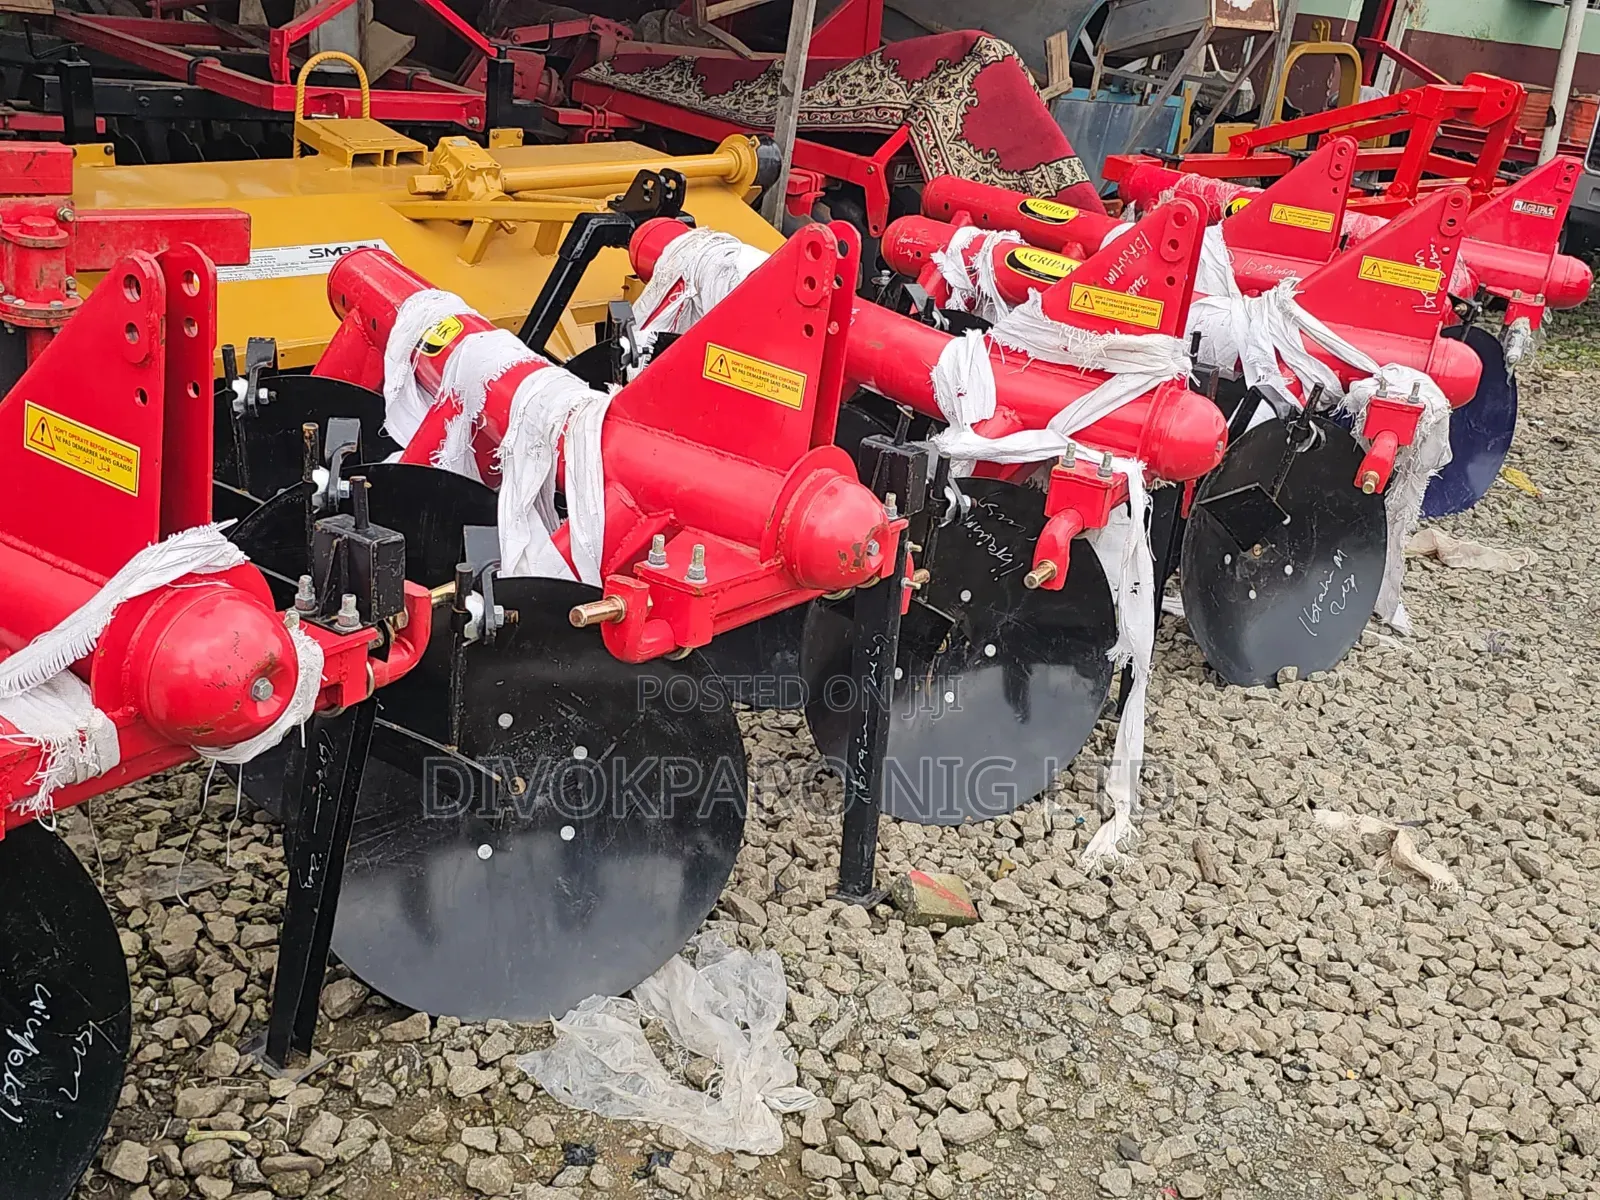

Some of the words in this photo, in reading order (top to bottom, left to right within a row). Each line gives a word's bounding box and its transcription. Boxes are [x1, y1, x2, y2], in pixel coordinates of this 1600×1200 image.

[1029, 201, 1075, 216] AGRIPAK
[53, 425, 68, 437] DON'T
[68, 432, 89, 446] OPERATE
[89, 441, 108, 454] BEFORE
[108, 449, 133, 465] CHECKING
[62, 437, 71, 447] PAS
[72, 441, 99, 459] DEMARRER
[99, 453, 112, 465] SANS
[112, 459, 133, 473] GRAISSE
